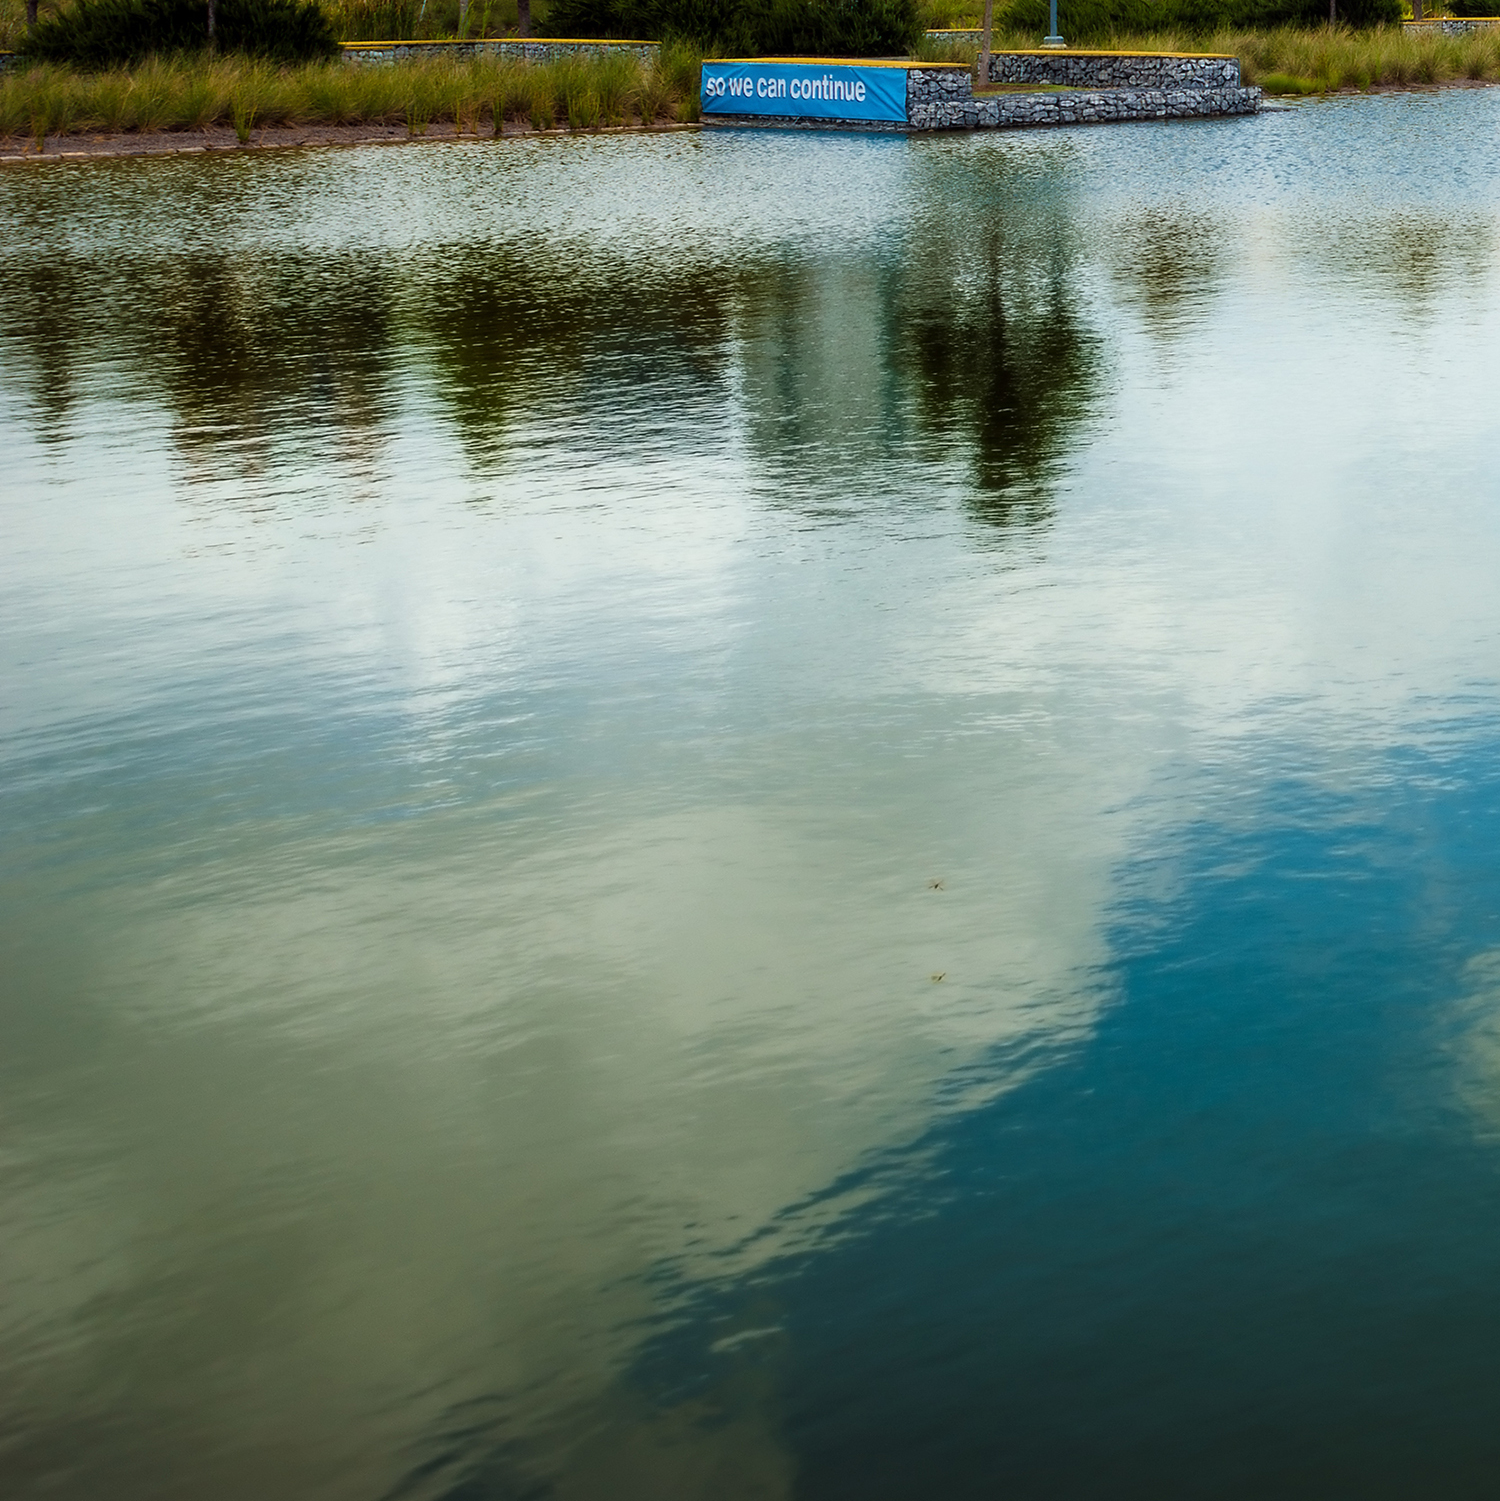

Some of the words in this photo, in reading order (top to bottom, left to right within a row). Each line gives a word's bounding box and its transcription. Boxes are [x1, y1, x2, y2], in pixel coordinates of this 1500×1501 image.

[706, 77, 726, 97] so
[729, 76, 753, 97] we
[756, 77, 787, 99] can
[789, 74, 866, 102] continue
